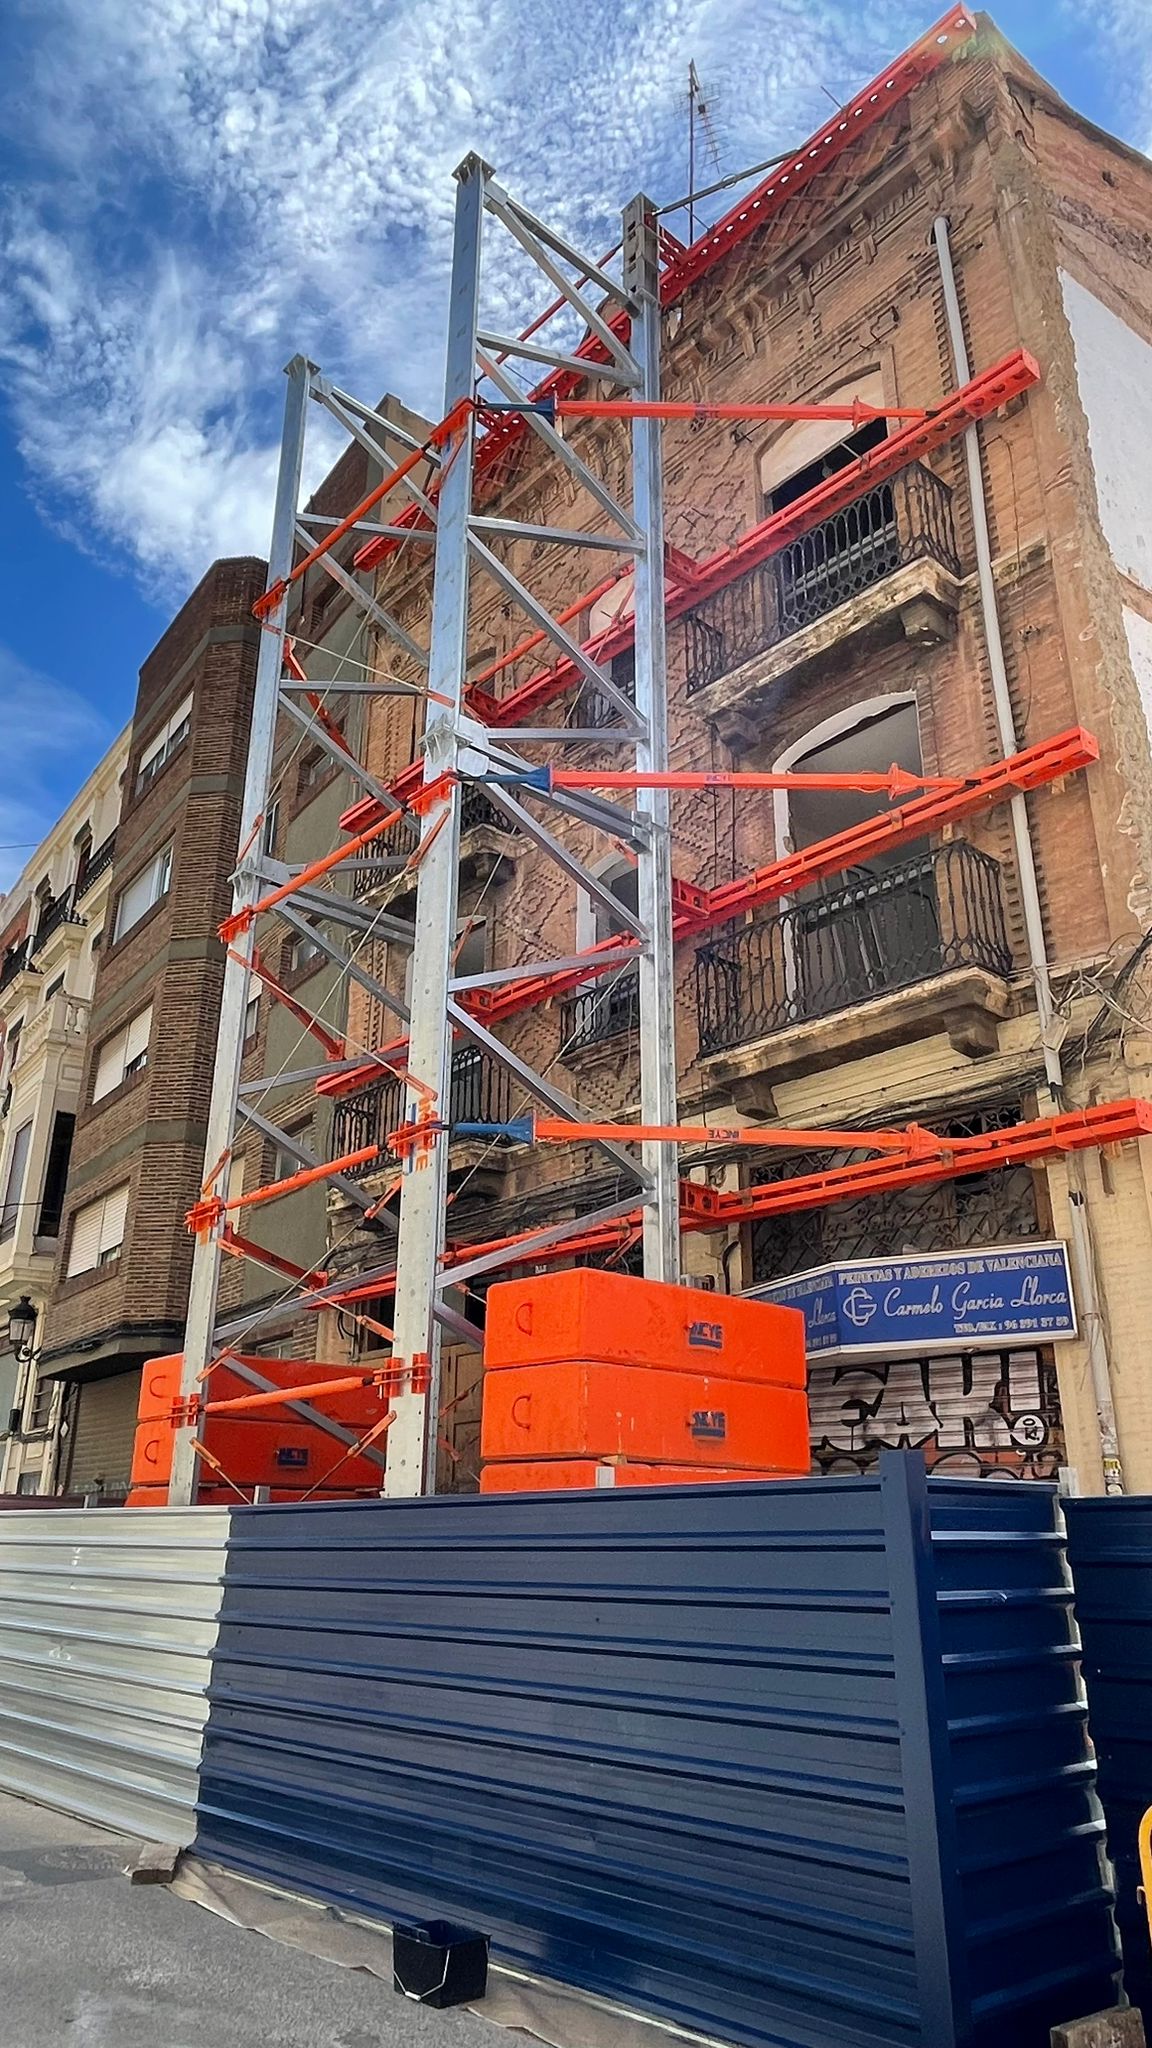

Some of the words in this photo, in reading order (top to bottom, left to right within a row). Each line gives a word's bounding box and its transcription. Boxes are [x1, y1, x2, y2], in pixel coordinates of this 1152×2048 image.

[893, 1266, 903, 1281] Y
[967, 1260, 985, 1274] DE
[883, 1284, 944, 1317] Carmelo
[951, 1281, 1004, 1321] Garcia
[1010, 1275, 1067, 1308] Llorca
